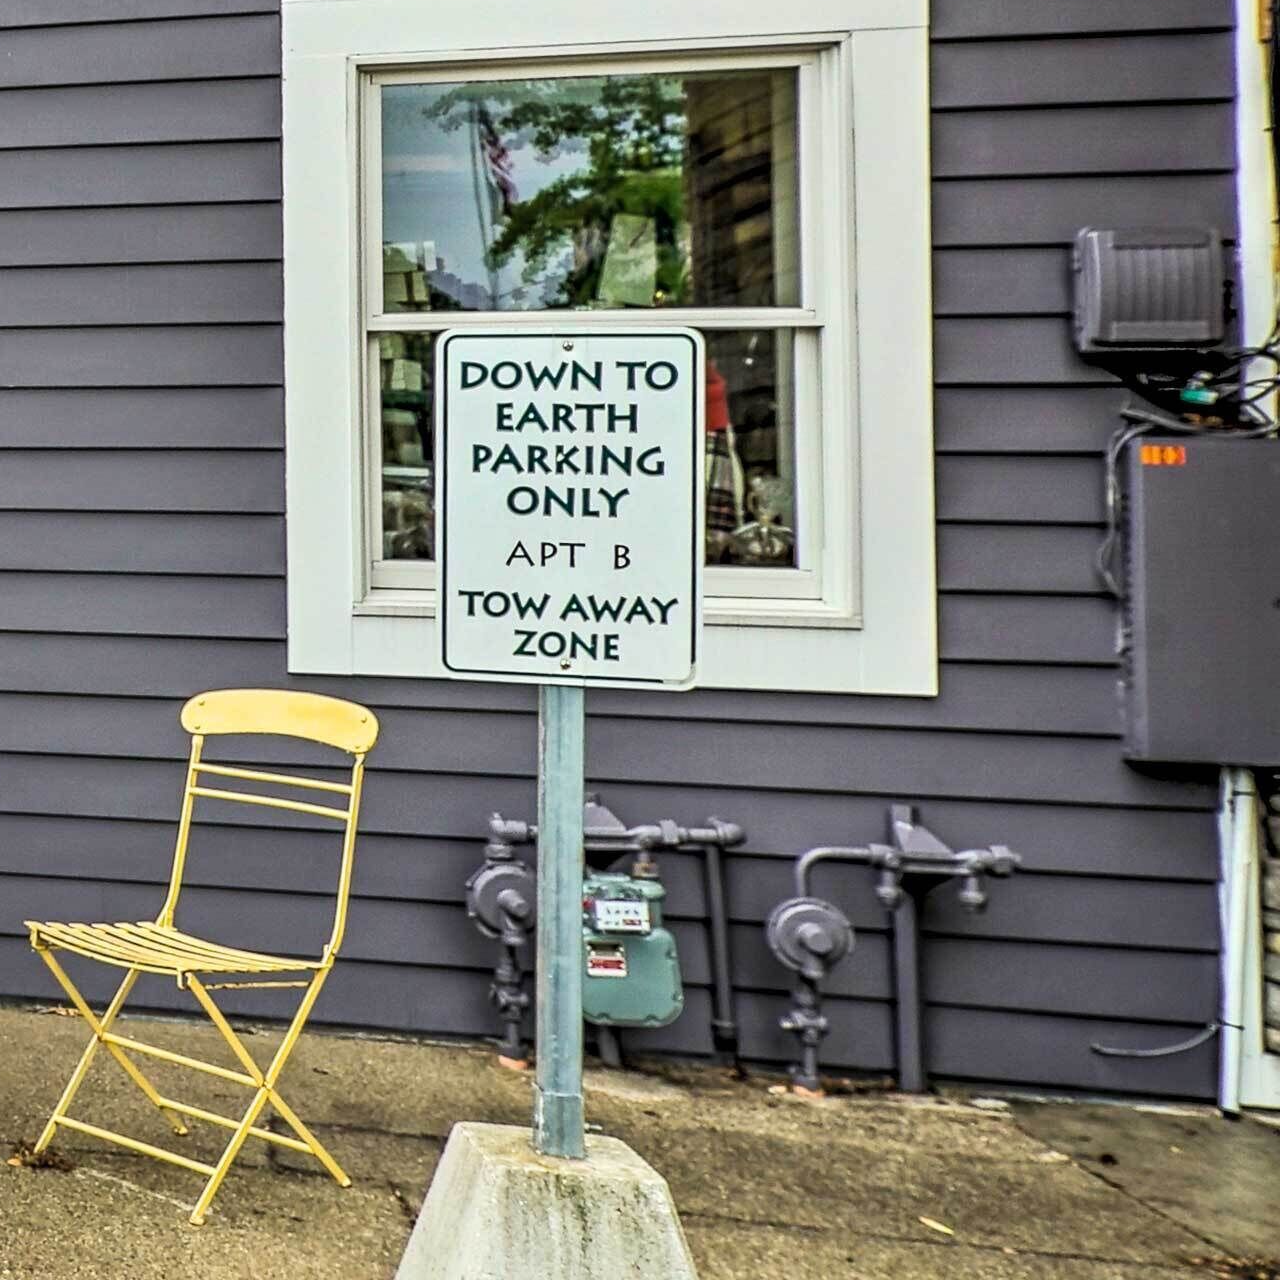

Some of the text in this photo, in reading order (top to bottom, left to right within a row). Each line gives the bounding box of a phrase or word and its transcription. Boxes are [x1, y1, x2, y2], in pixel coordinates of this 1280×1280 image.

[461, 361, 678, 391] DOWN TO
[497, 403, 637, 433] EARTH
[473, 444, 664, 476] PARKING
[507, 486, 629, 517] ONLY
[506, 541, 630, 569] APT B
[458, 590, 678, 624] TOW AWAY
[513, 630, 619, 661] ZONE
